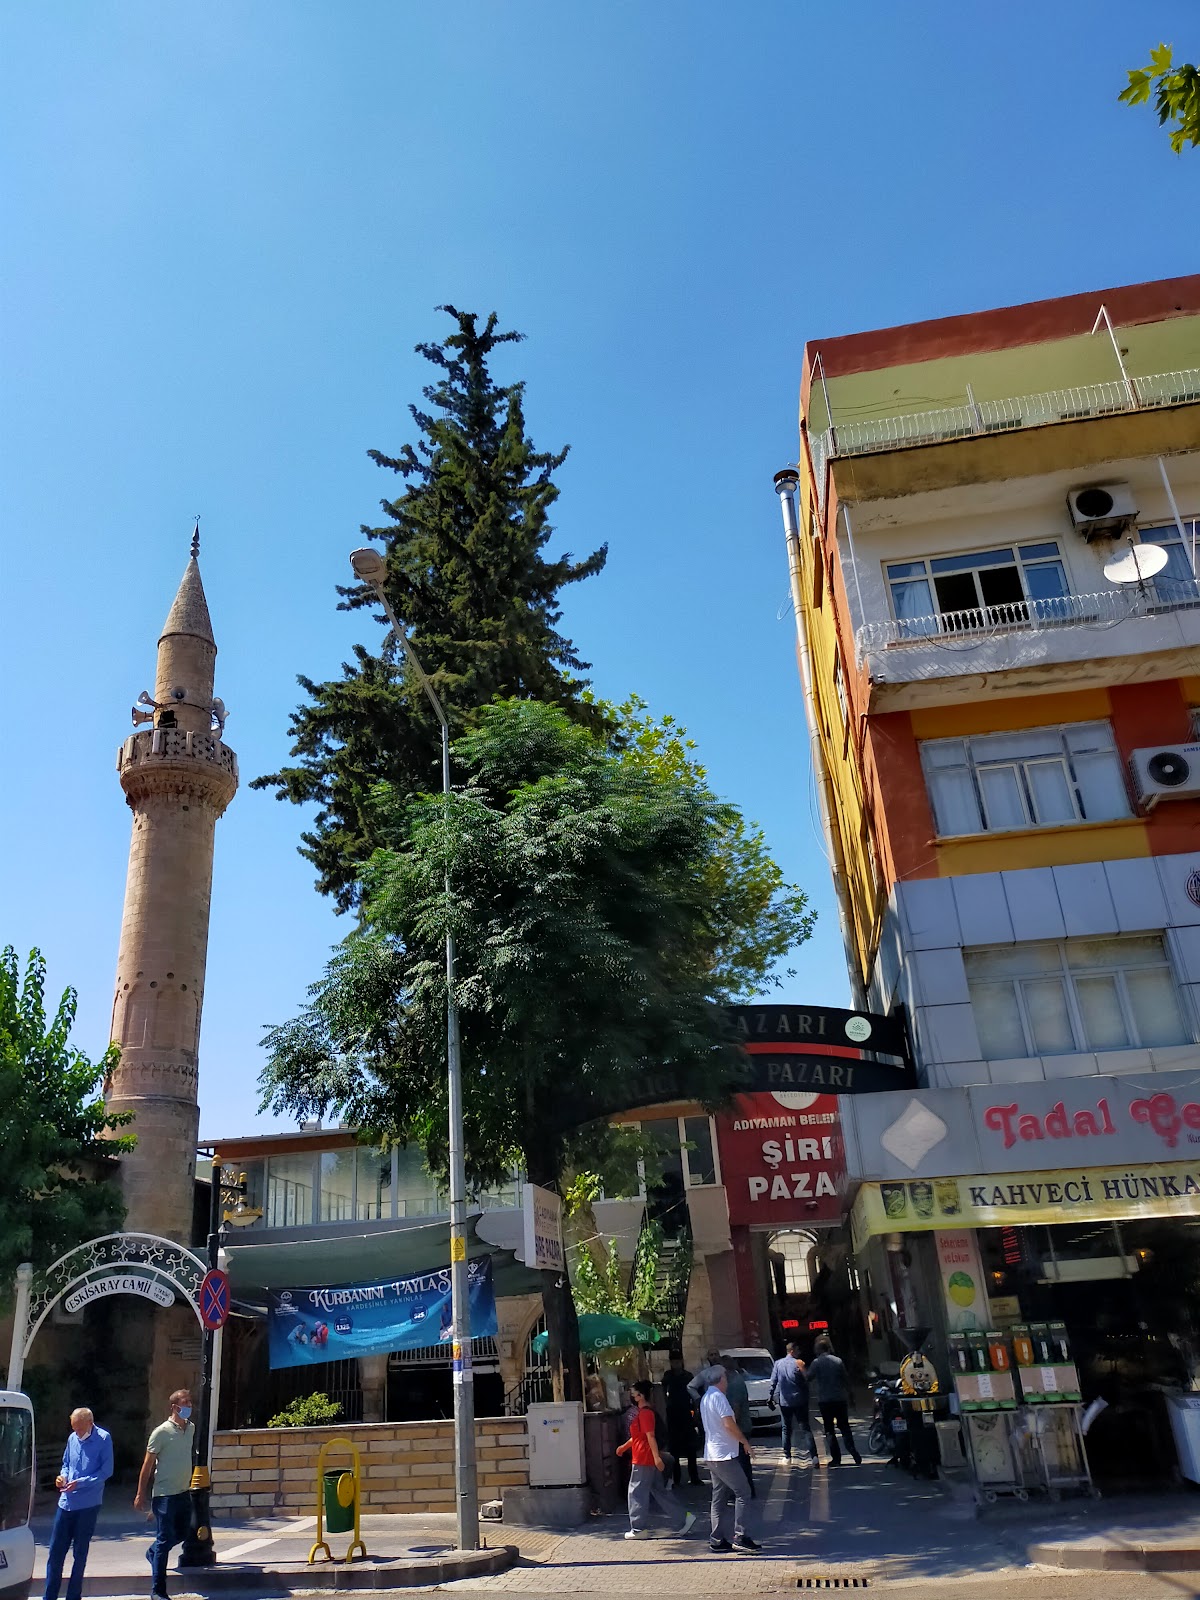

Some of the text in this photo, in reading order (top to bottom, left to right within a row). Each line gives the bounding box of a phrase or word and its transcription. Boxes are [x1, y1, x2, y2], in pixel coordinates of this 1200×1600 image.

[736, 1014, 826, 1035] AZARI
[767, 1063, 853, 1088] PAZARI
[733, 1115, 796, 1131] ADIYAMAN
[984, 1098, 1116, 1149] Tadal
[968, 1173, 1200, 1207] KAHVECİ HÜNKA
[309, 1286, 384, 1312] KURBANINI
[392, 1270, 451, 1296] PAYLAŞ
[346, 1295, 423, 1311] KARDEŞİNLE YAKINLAŞ
[594, 1334, 616, 1348] Golf
[635, 1330, 649, 1341] Golf
